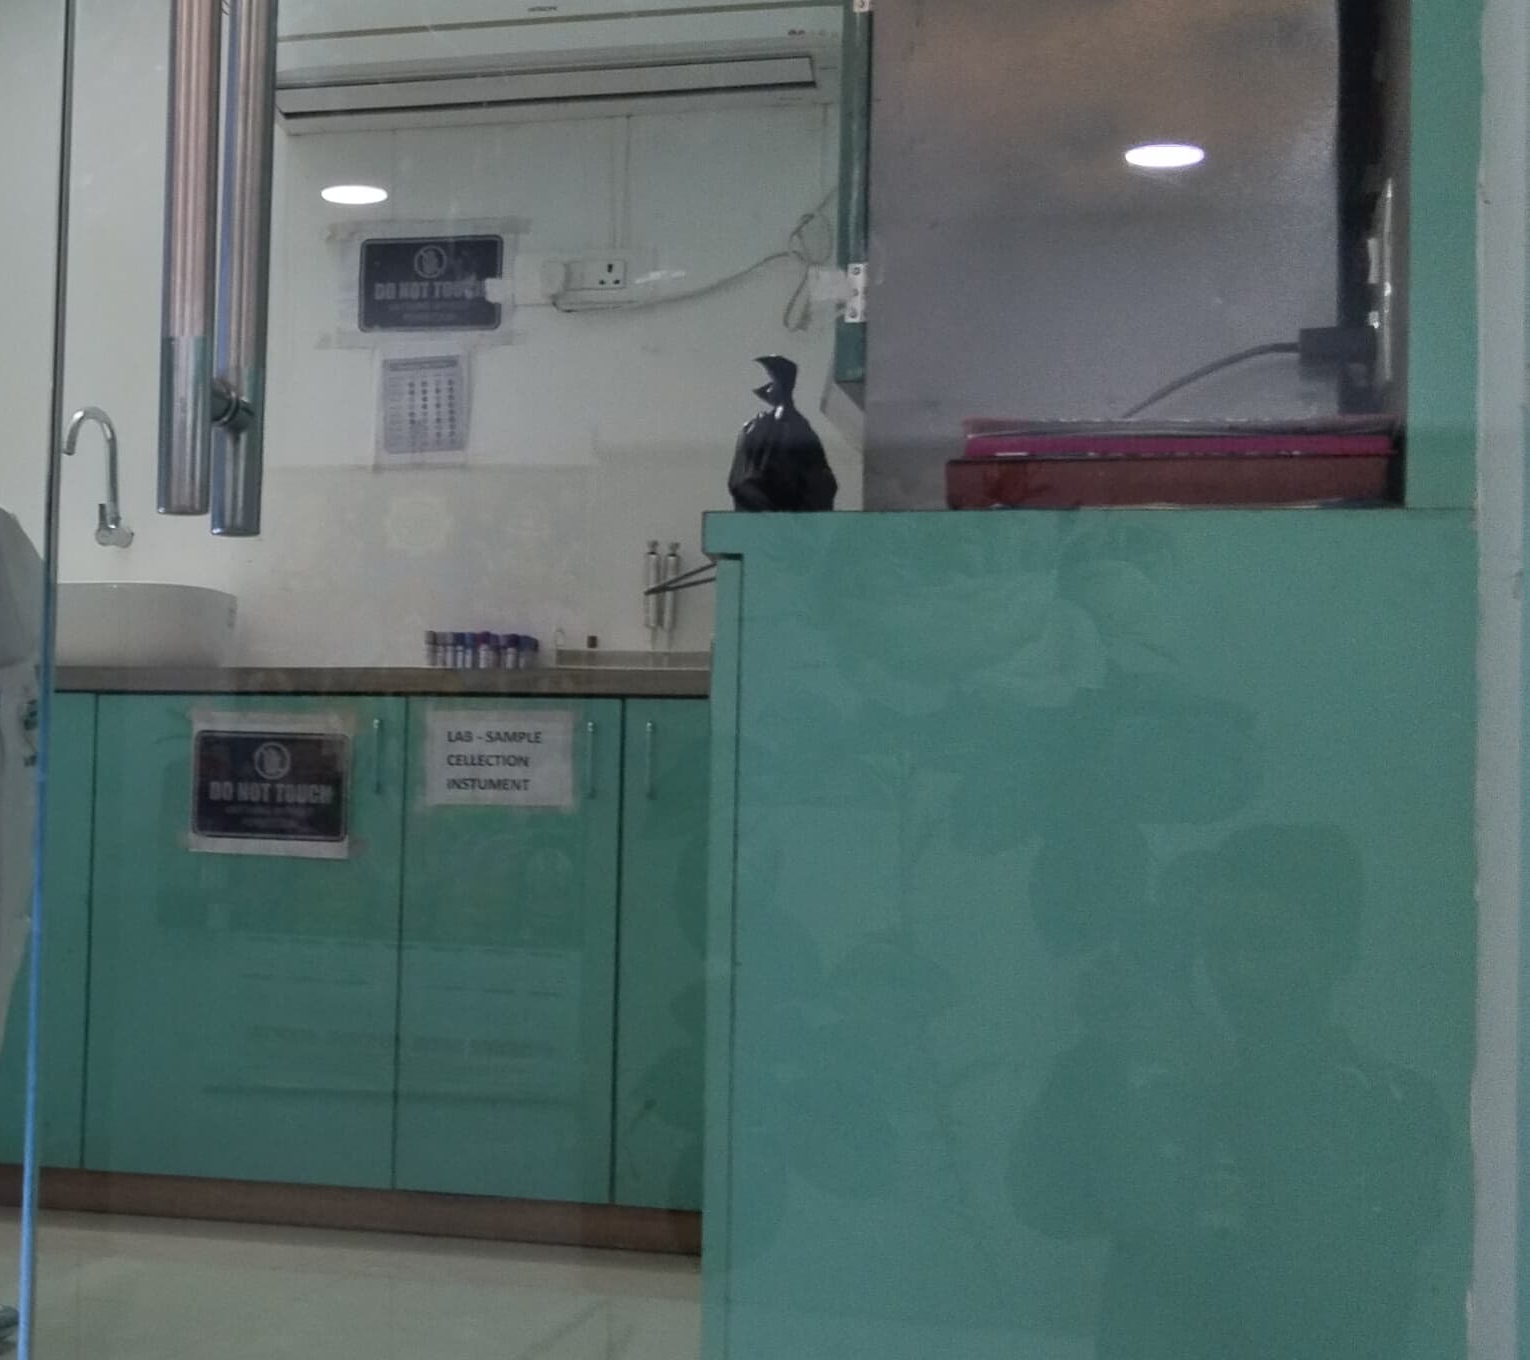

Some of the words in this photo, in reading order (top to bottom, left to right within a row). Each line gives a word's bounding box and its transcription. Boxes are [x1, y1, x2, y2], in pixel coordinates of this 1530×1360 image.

[374, 283, 396, 300] DO
[398, 281, 429, 299] NOT
[446, 730, 473, 743] LAB
[485, 730, 543, 744] SAMPLE
[209, 781, 234, 801] DO
[237, 781, 271, 803] NOT
[275, 783, 333, 804] TOUCH
